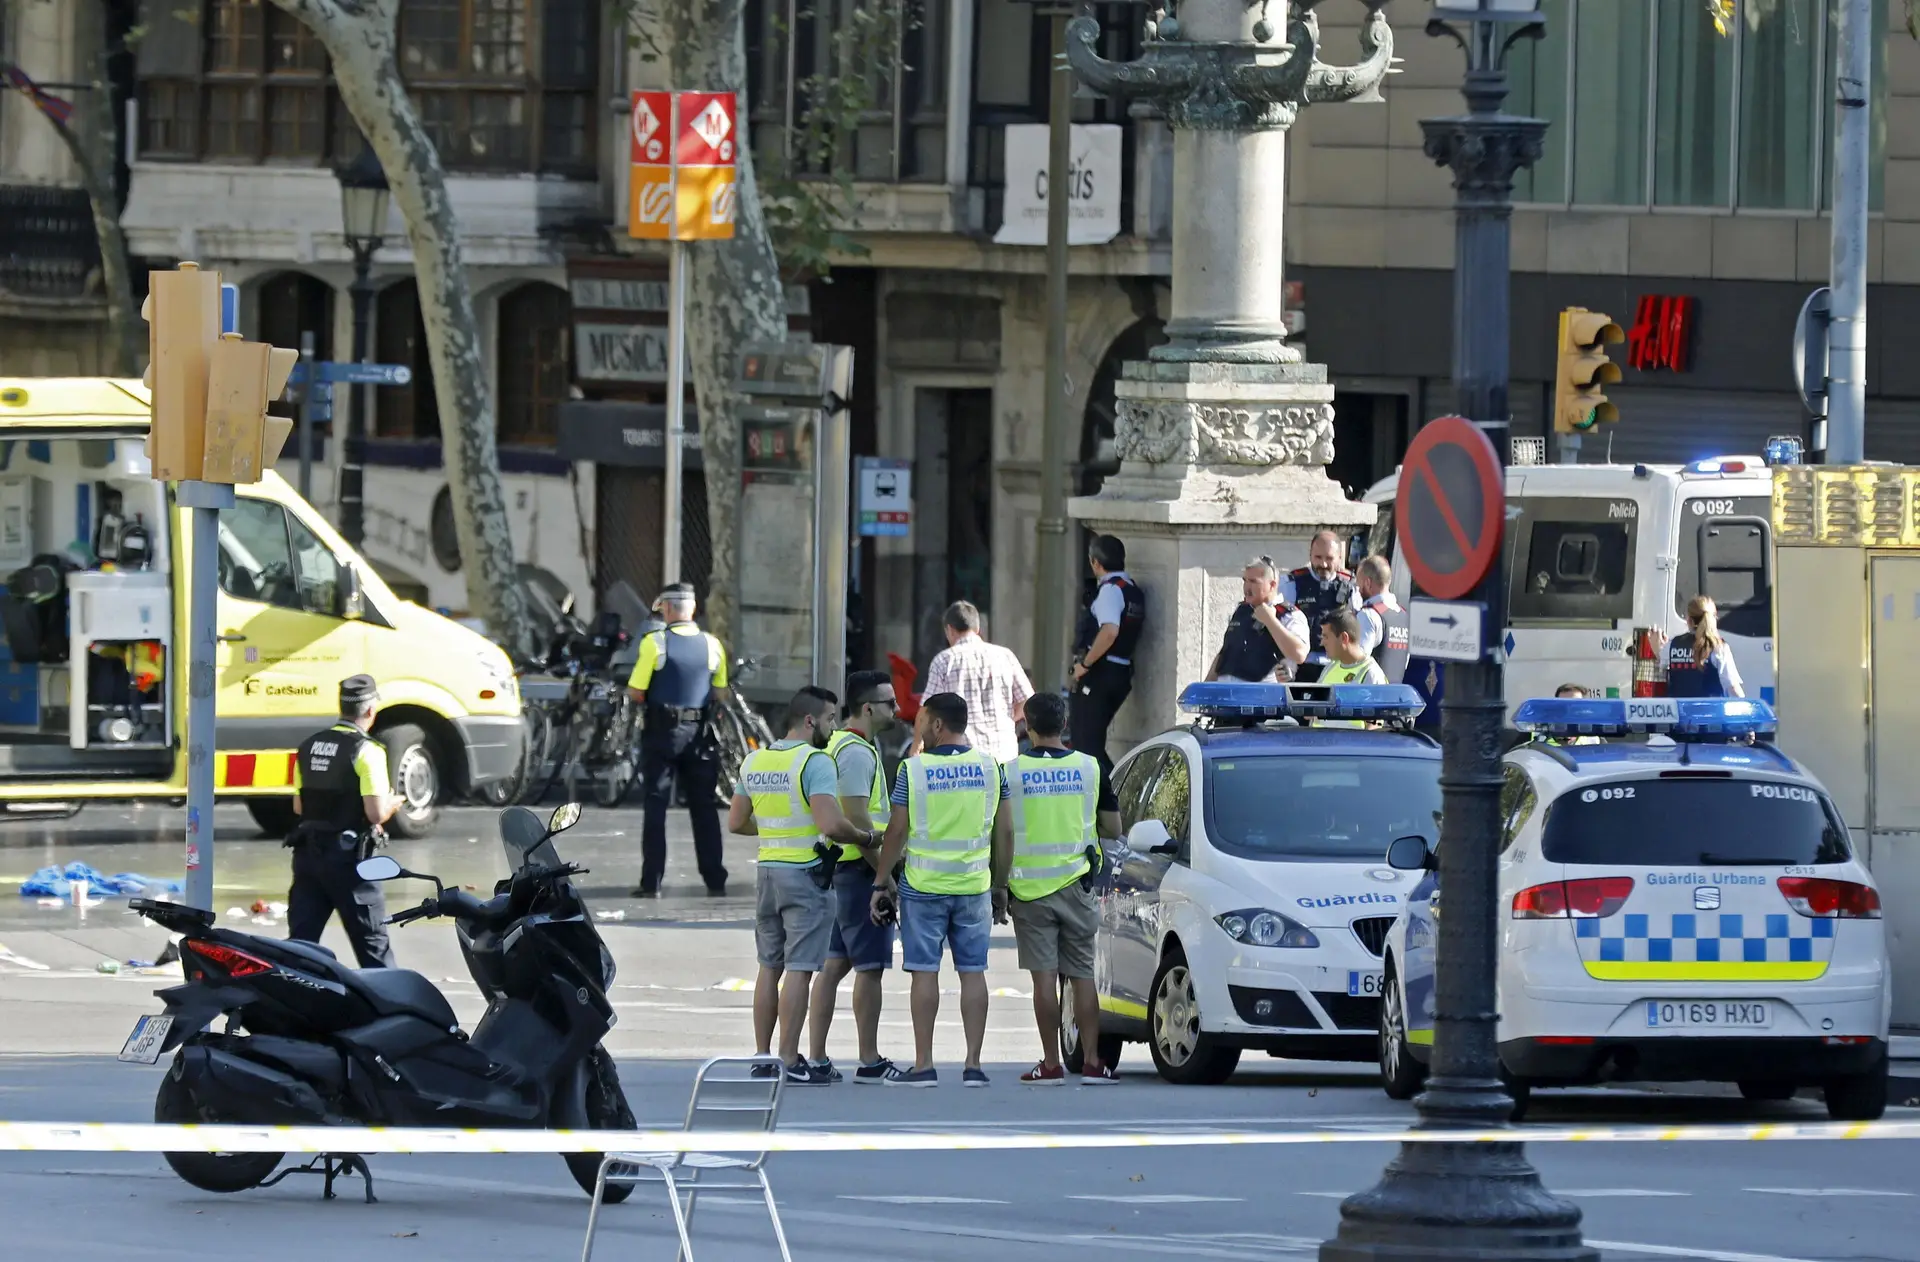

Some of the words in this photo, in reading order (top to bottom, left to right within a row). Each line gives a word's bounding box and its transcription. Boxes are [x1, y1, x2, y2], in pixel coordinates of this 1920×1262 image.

[706, 113, 722, 135] M
[1035, 158, 1095, 200] ctis
[588, 331, 669, 373] MUSICA
[1608, 502, 1636, 519] Policia
[1706, 500, 1734, 515] 092
[1388, 626, 1409, 639] POLIC
[1608, 637, 1623, 651] 092
[1763, 642, 1773, 652] G
[1671, 647, 1695, 658] POLI
[265, 685, 318, 695] CatSalut
[1629, 705, 1674, 718] POLICIA
[310, 741, 339, 757] POLICIA
[746, 773, 790, 785] POLICIA
[925, 765, 984, 780] POLICIA
[1021, 769, 1083, 785] POLICIA
[1023, 785, 1047, 795] MOSSOS
[1601, 787, 1635, 800] 092
[1750, 785, 1818, 804] POLICIA
[1646, 873, 1706, 886] Guàrdia
[1712, 872, 1766, 886] Urbana
[1296, 892, 1398, 909] Guàrdia
[1364, 975, 1384, 993] 68
[1662, 1003, 1716, 1023] 0169
[1724, 1003, 1765, 1024] HXD
[143, 1019, 169, 1036] 1679
[131, 1036, 155, 1053] JGP
